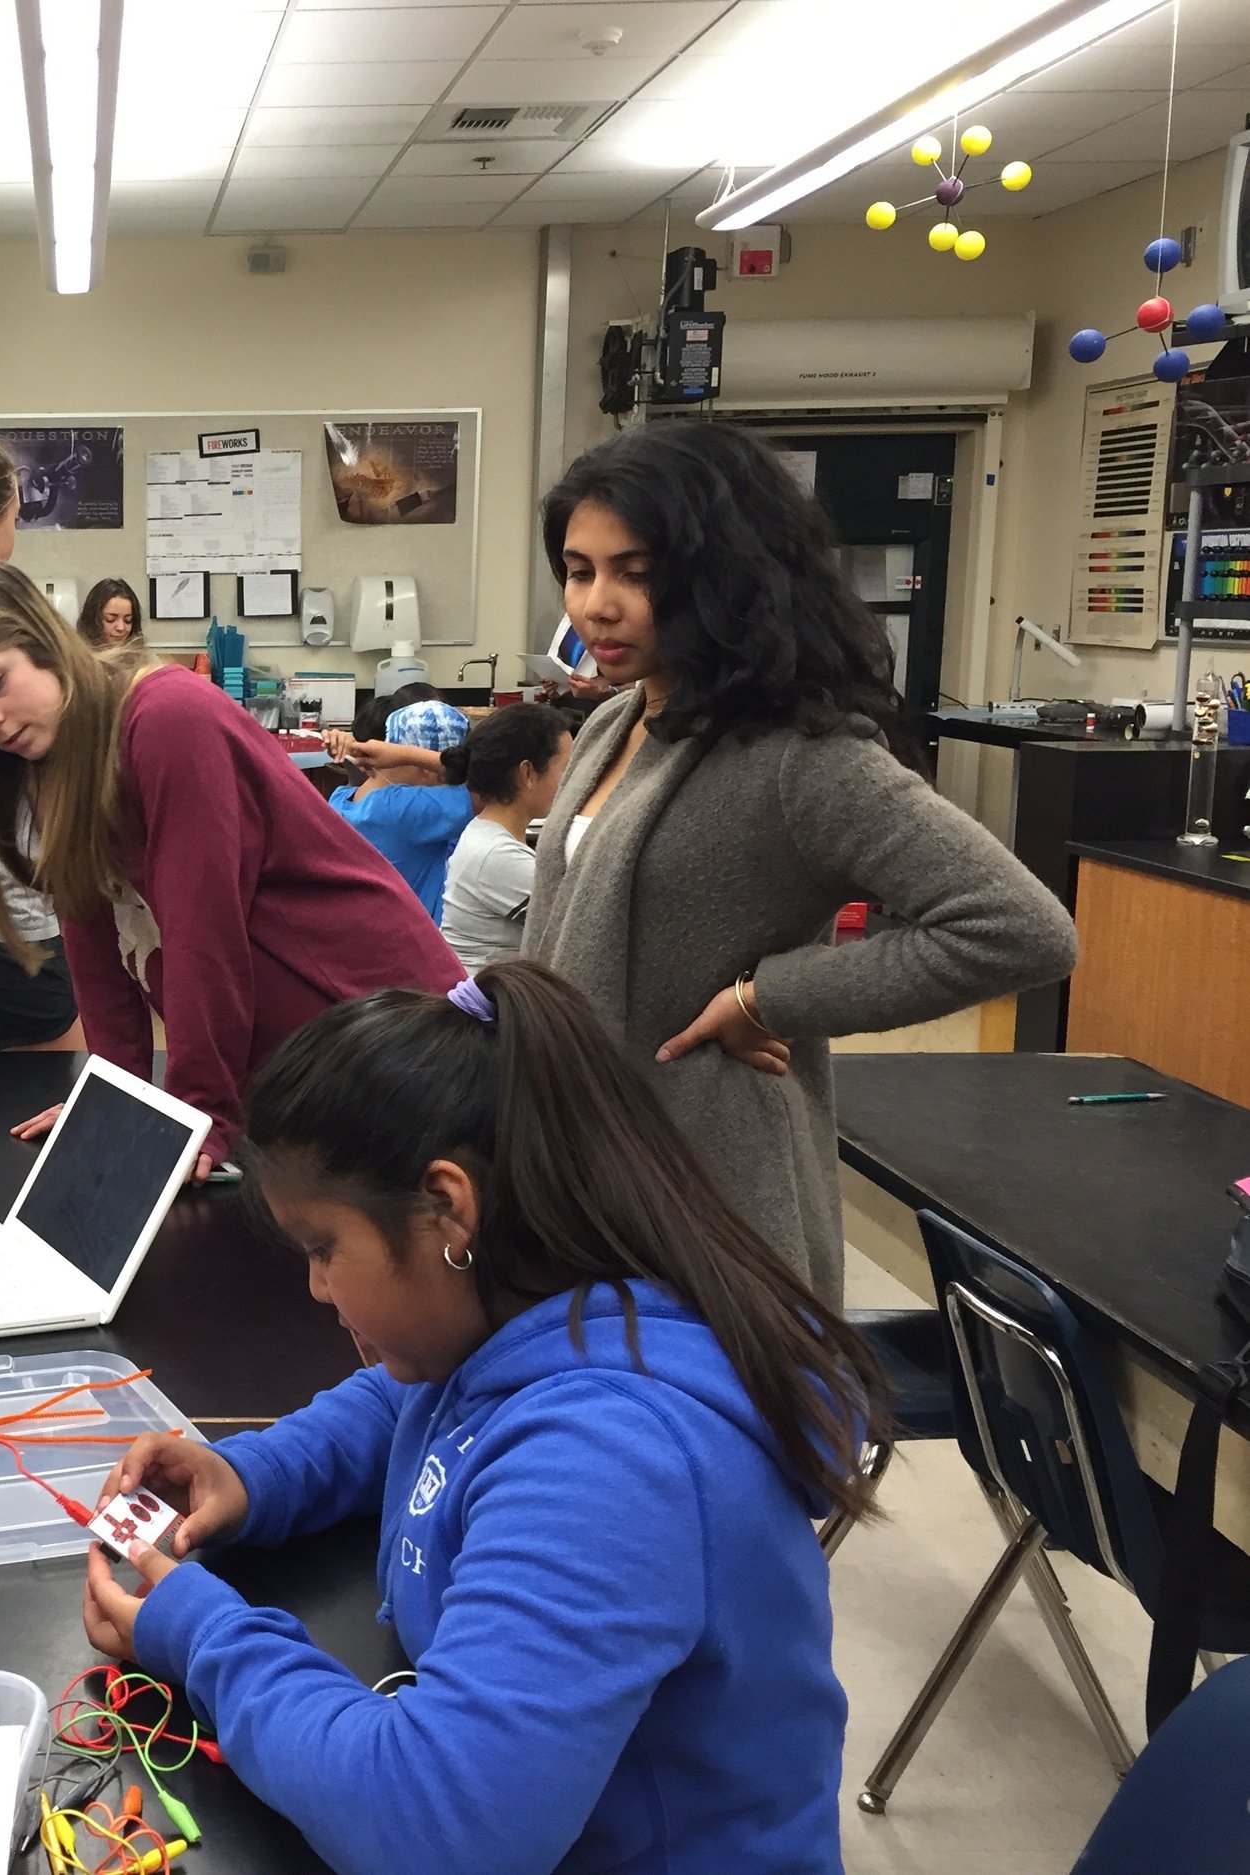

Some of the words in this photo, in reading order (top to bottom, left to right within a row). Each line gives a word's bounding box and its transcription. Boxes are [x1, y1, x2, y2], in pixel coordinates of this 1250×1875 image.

[6, 431, 109, 441] QUESTION
[336, 425, 447, 436] ENDEAVOR
[207, 437, 248, 450] FIREWORKS
